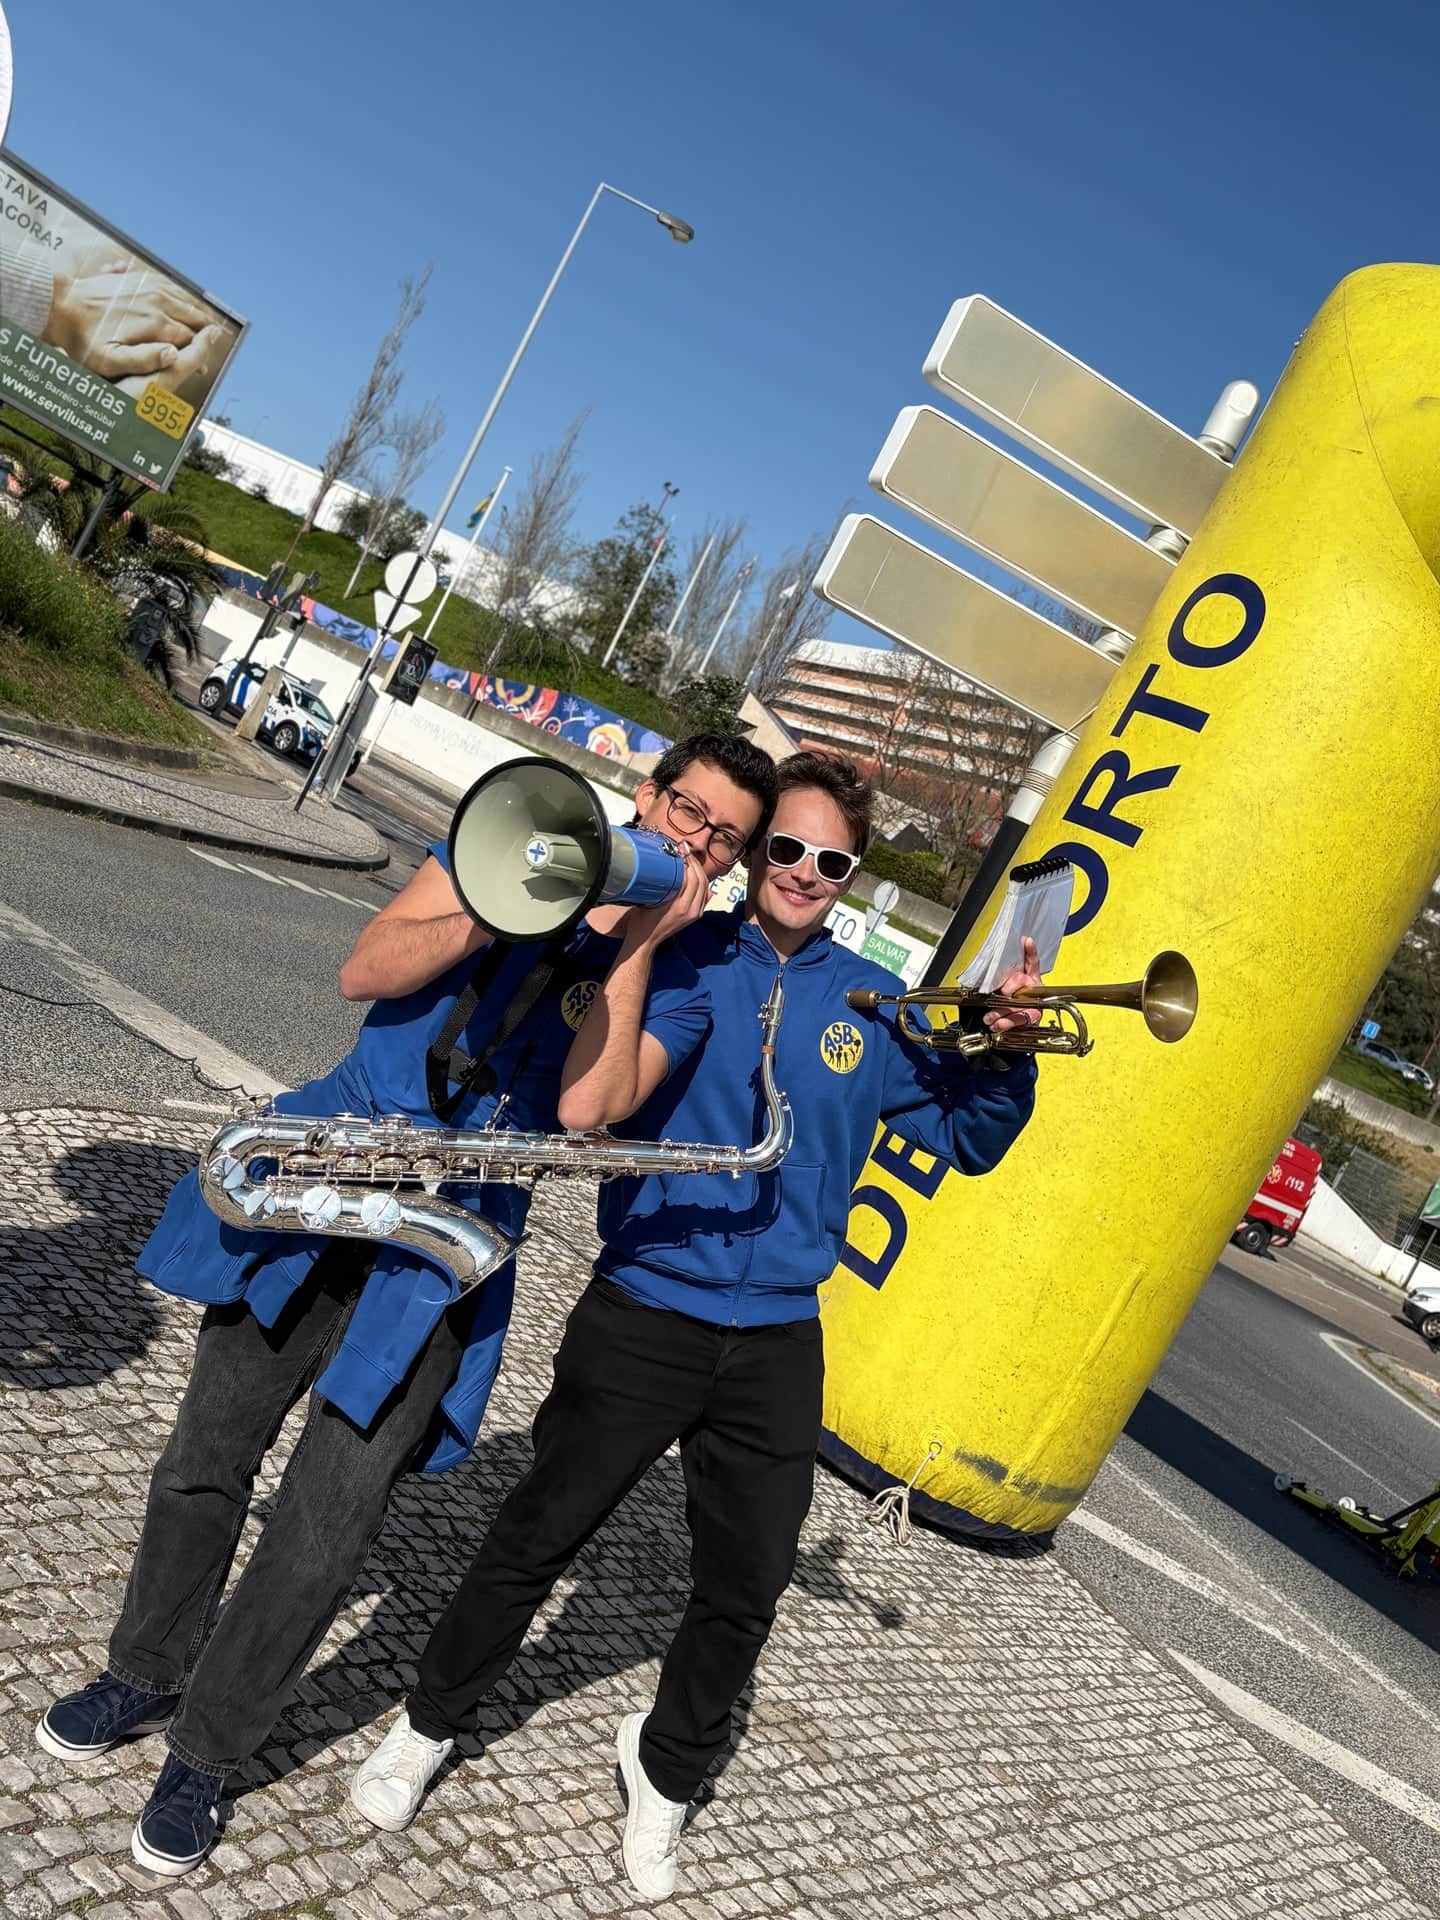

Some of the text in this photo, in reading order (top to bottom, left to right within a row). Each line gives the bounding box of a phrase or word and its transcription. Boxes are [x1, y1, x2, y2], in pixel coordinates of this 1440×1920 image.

[15, 334, 126, 416] Funerárias
[2, 373, 110, 444] www.servilusa.pt
[44, 380, 79, 407] Barreiro
[868, 937, 906, 964] SALVAR
[824, 1023, 854, 1054] ASB
